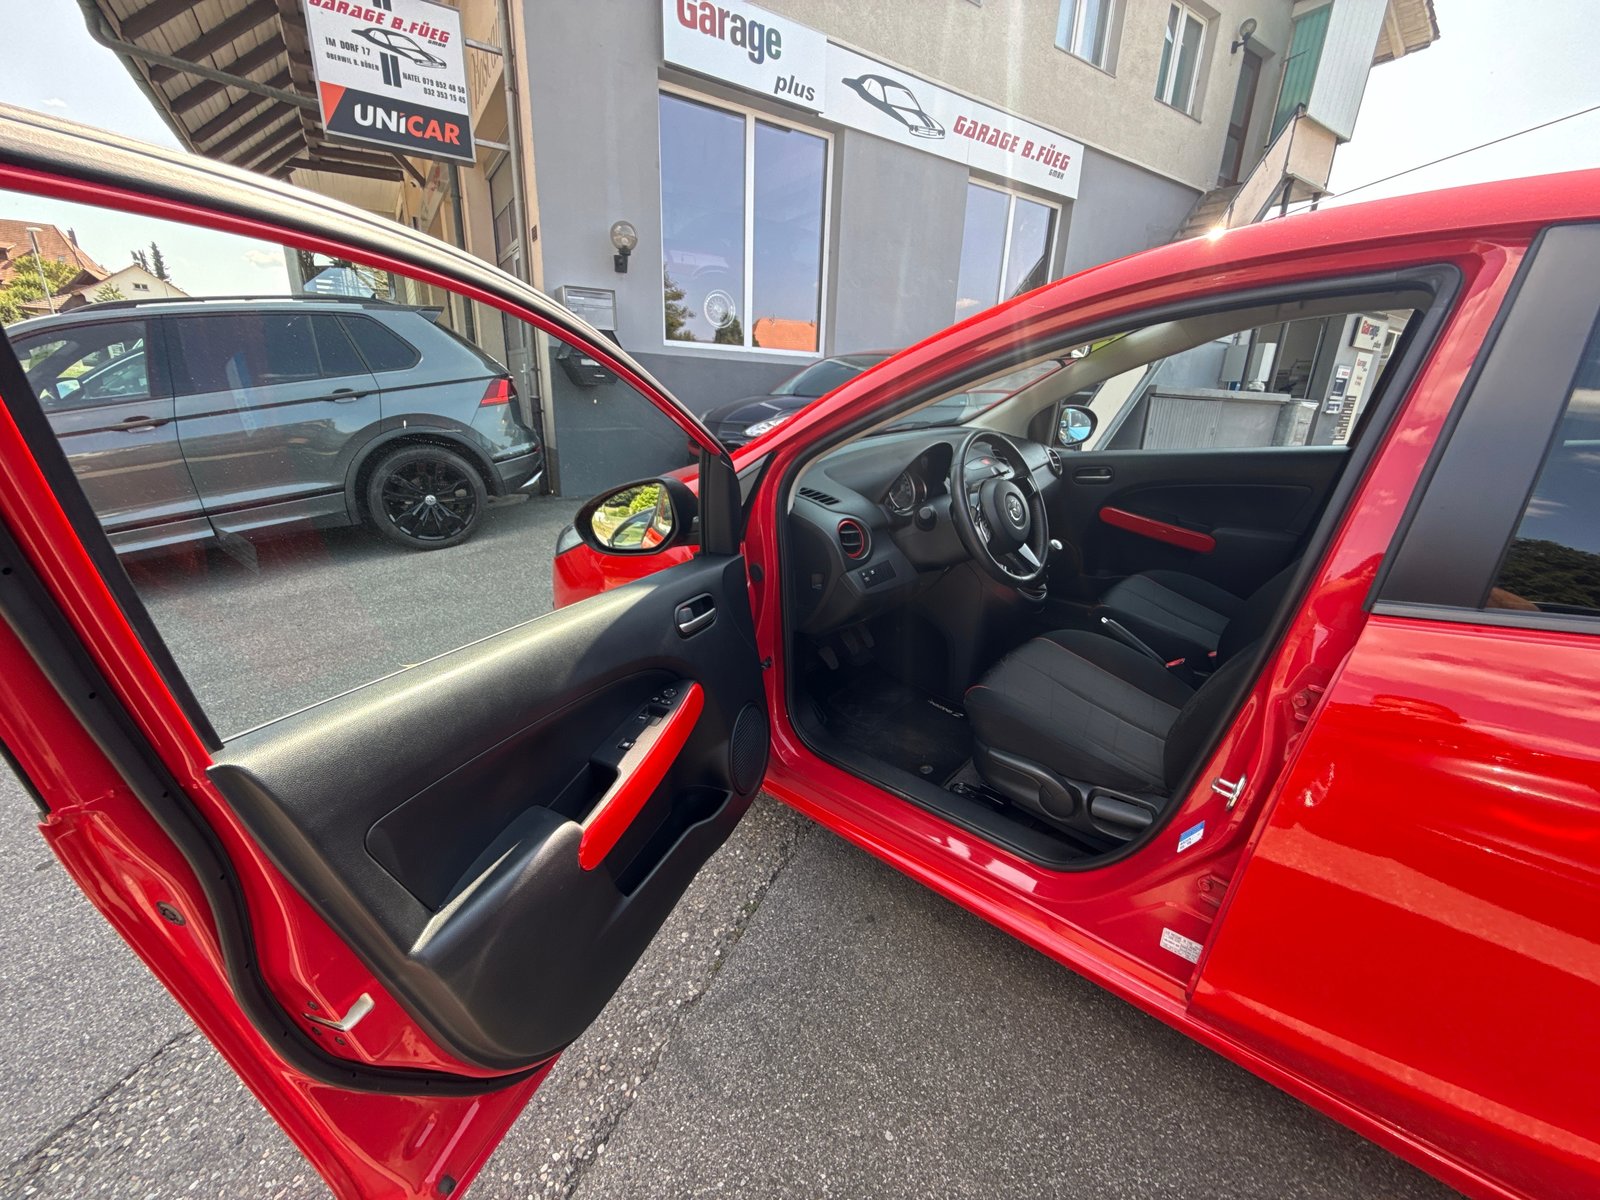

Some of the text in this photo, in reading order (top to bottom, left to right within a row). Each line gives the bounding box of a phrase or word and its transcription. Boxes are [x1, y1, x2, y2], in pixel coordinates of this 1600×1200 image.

[391, 17, 450, 43] B.FÜEG
[677, 0, 782, 65] Garage
[325, 36, 371, 56] IM DORF 17
[326, 52, 352, 64] OBERWIL
[402, 72, 421, 84] NATEL
[774, 75, 816, 102] plus
[953, 115, 1071, 171] GARAGE B.FÜEG
